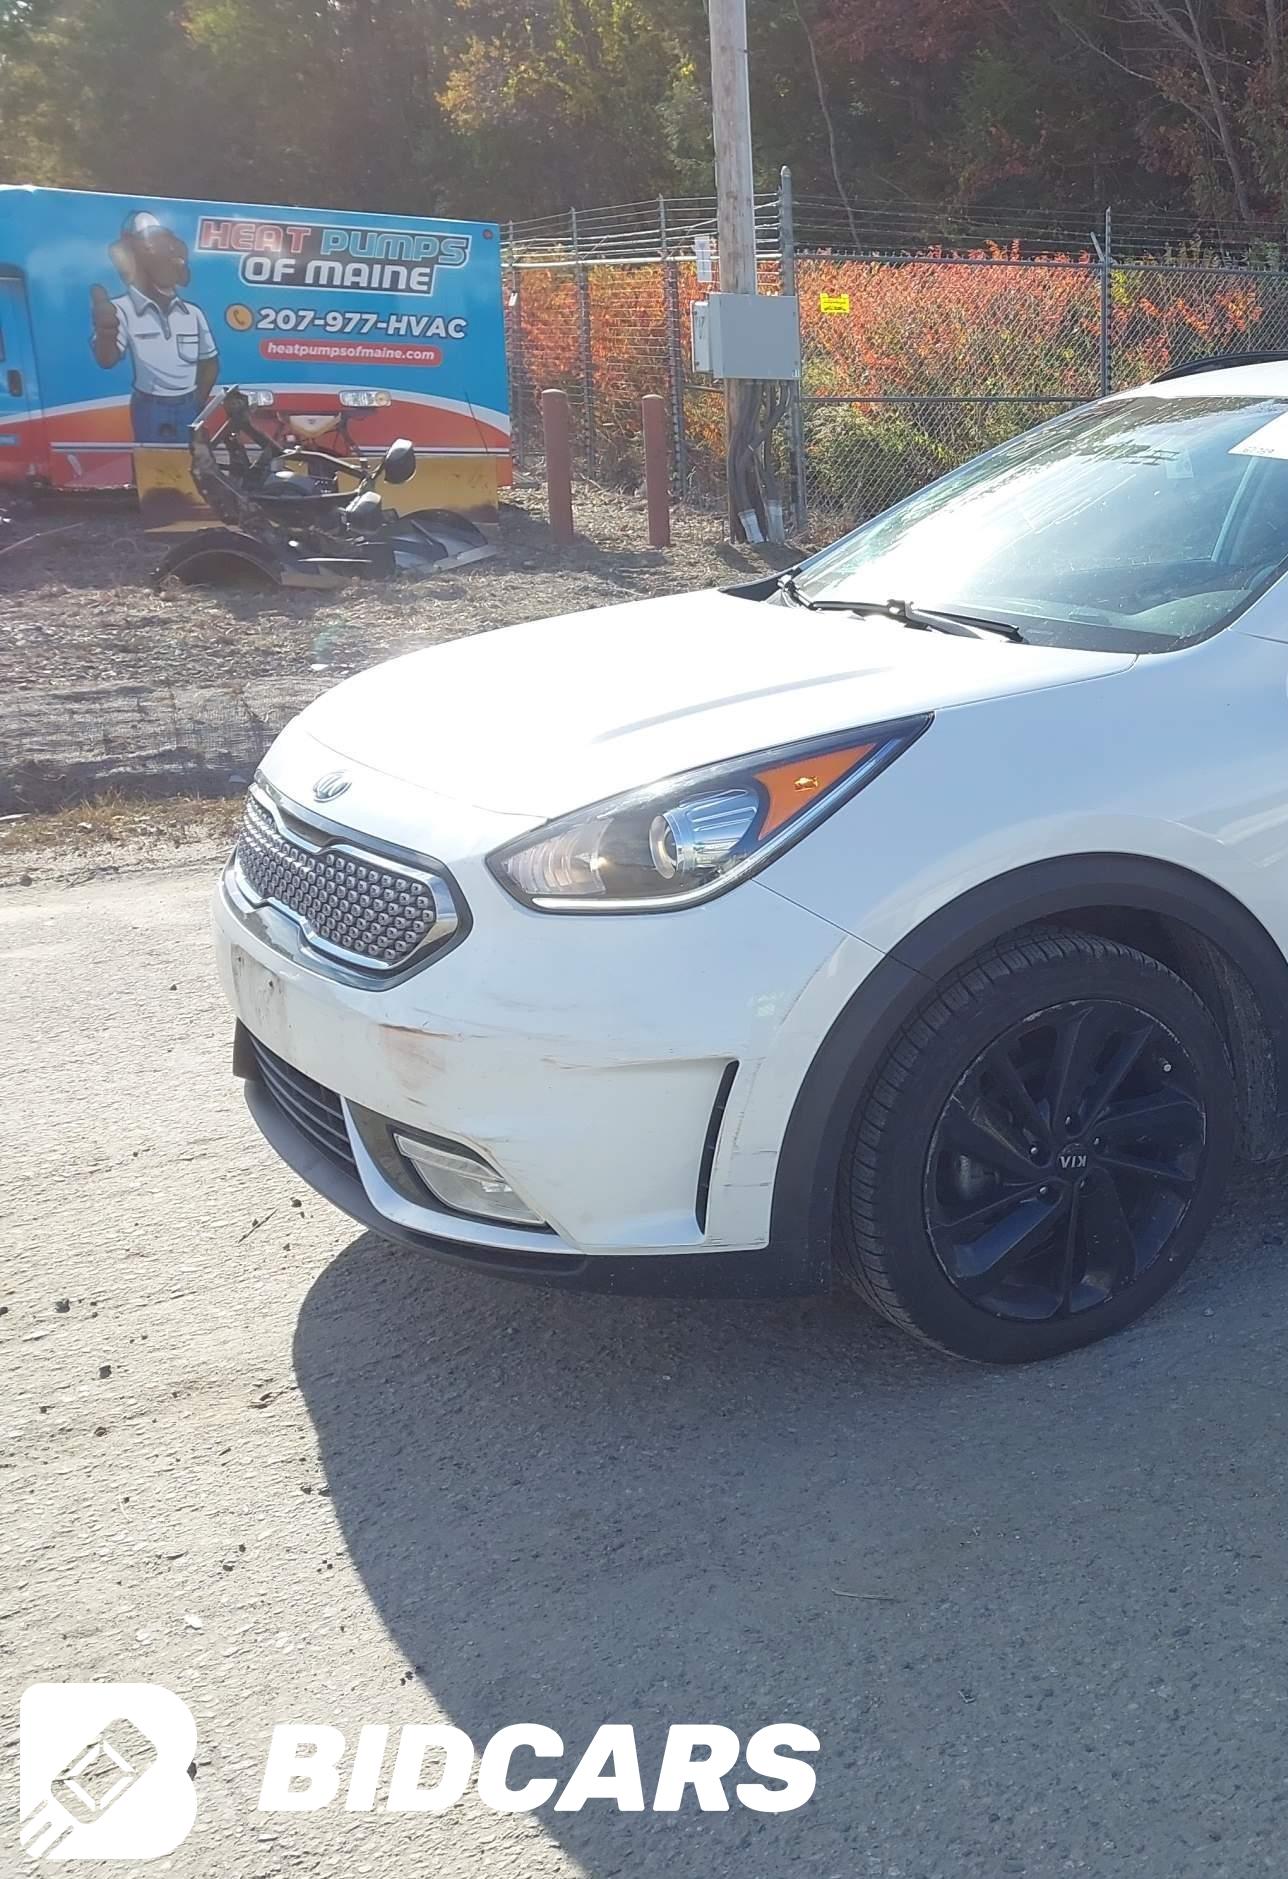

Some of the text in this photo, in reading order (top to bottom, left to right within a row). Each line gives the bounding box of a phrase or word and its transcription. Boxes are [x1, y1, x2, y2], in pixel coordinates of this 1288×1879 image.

[200, 221, 466, 264] HEAT PUMPS
[244, 256, 431, 291] OF MAINE
[256, 307, 467, 339] 207-977-HVAC
[267, 342, 435, 361] heatpumpsofmaine.com
[1060, 1155, 1087, 1168] KIA
